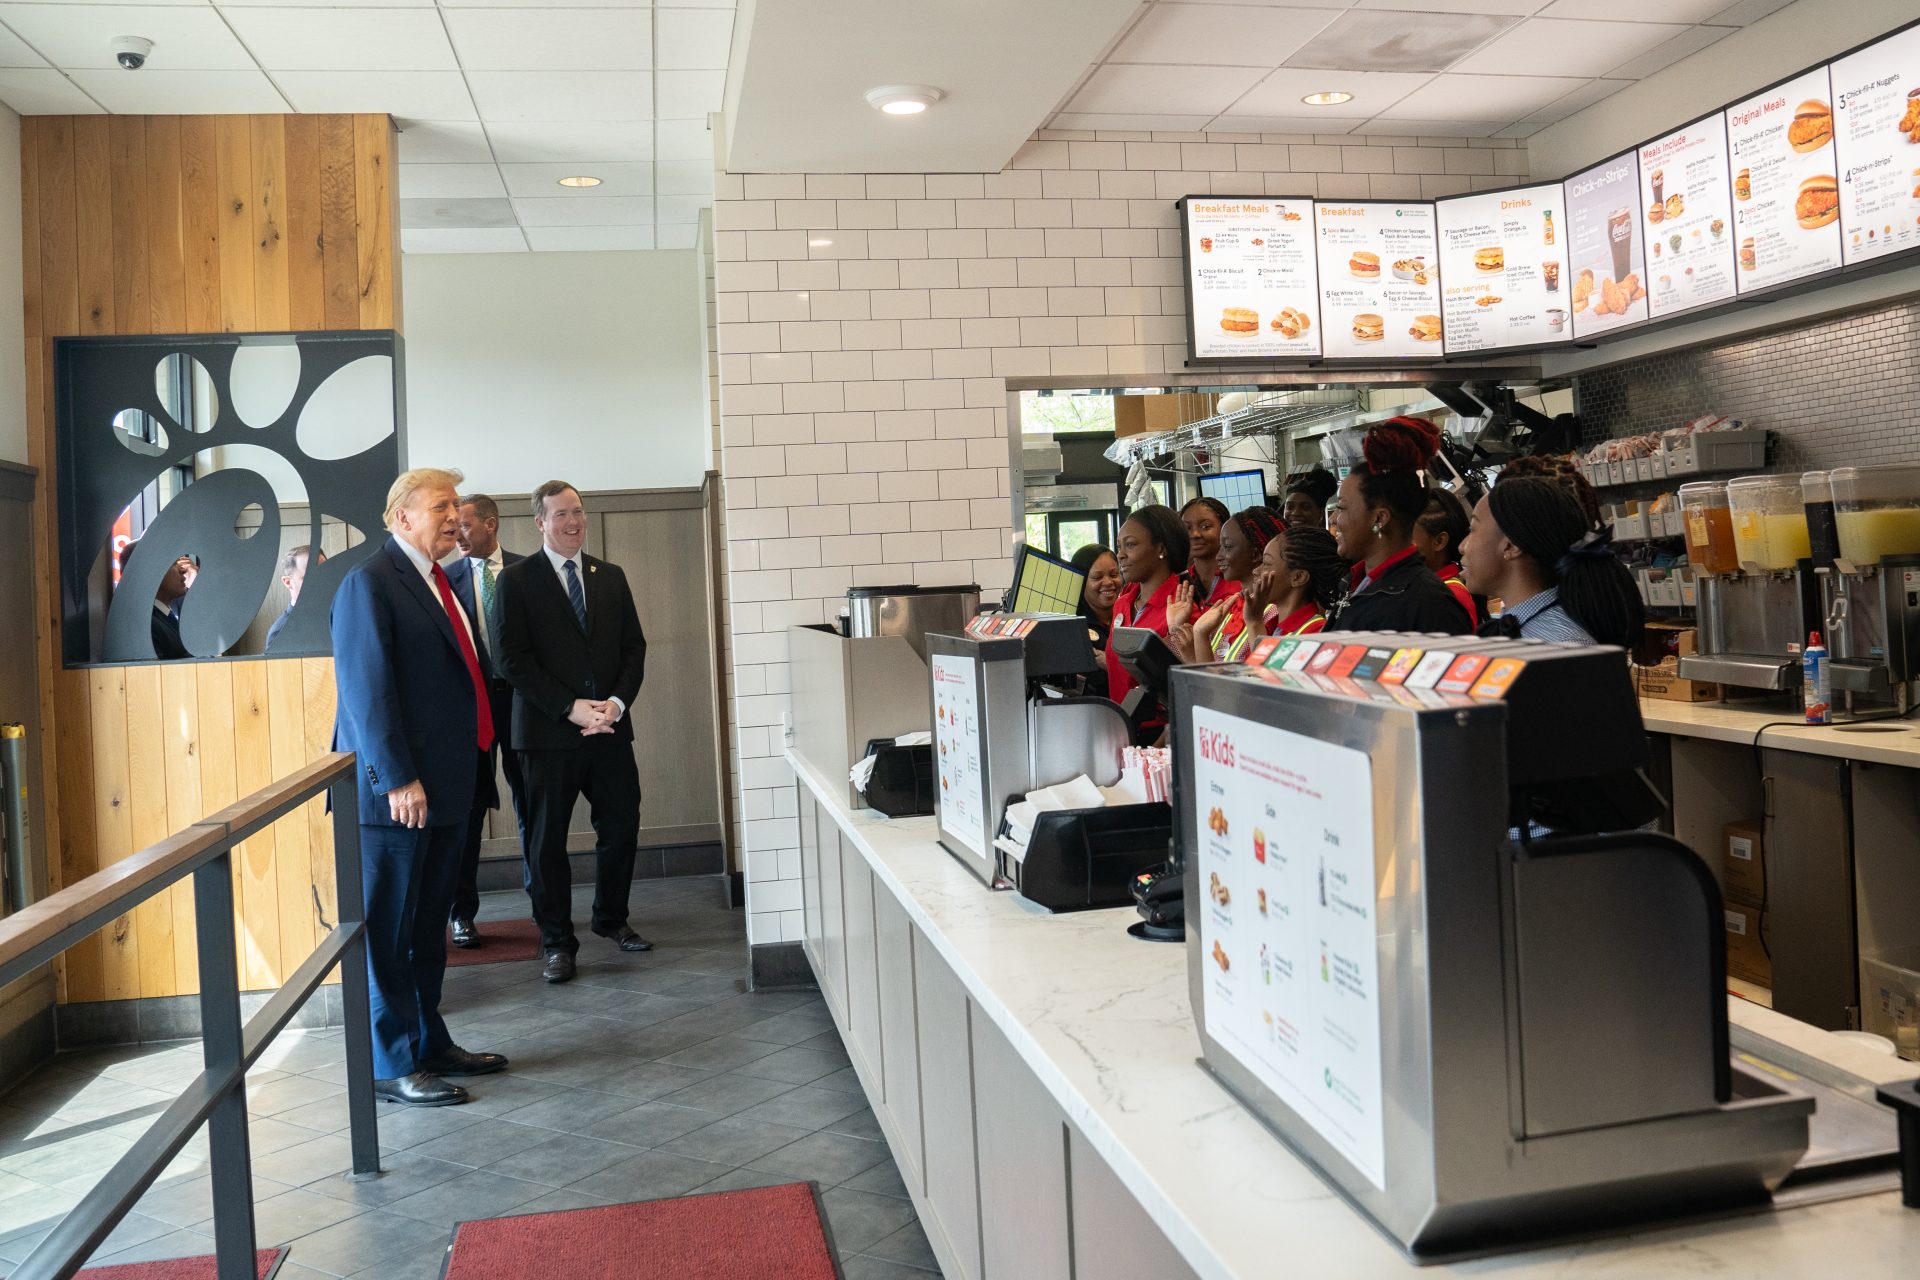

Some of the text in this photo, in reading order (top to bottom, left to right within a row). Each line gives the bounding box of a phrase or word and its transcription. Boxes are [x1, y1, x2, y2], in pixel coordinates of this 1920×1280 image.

[1876, 73, 1900, 88] Nuggets
[1839, 94, 1846, 109] 3
[1732, 97, 1786, 127] Original Meals
[1734, 141, 1739, 156] 1
[1764, 123, 1784, 136] Chicken
[1643, 135, 1687, 160] Meals Include
[1845, 169, 1852, 184] 4
[1194, 203, 1270, 213] Breakfast Meals
[1320, 207, 1365, 216] Breakfast
[1501, 198, 1532, 210] Drinks
[1738, 209, 1744, 224] 2
[1757, 200, 1776, 210] Chicken
[1444, 229, 1449, 238] 7
[1326, 290, 1331, 298] 5
[1445, 283, 1490, 295] also serving
[1210, 729, 1235, 768] Kids
[1323, 827, 1340, 847] Drink
